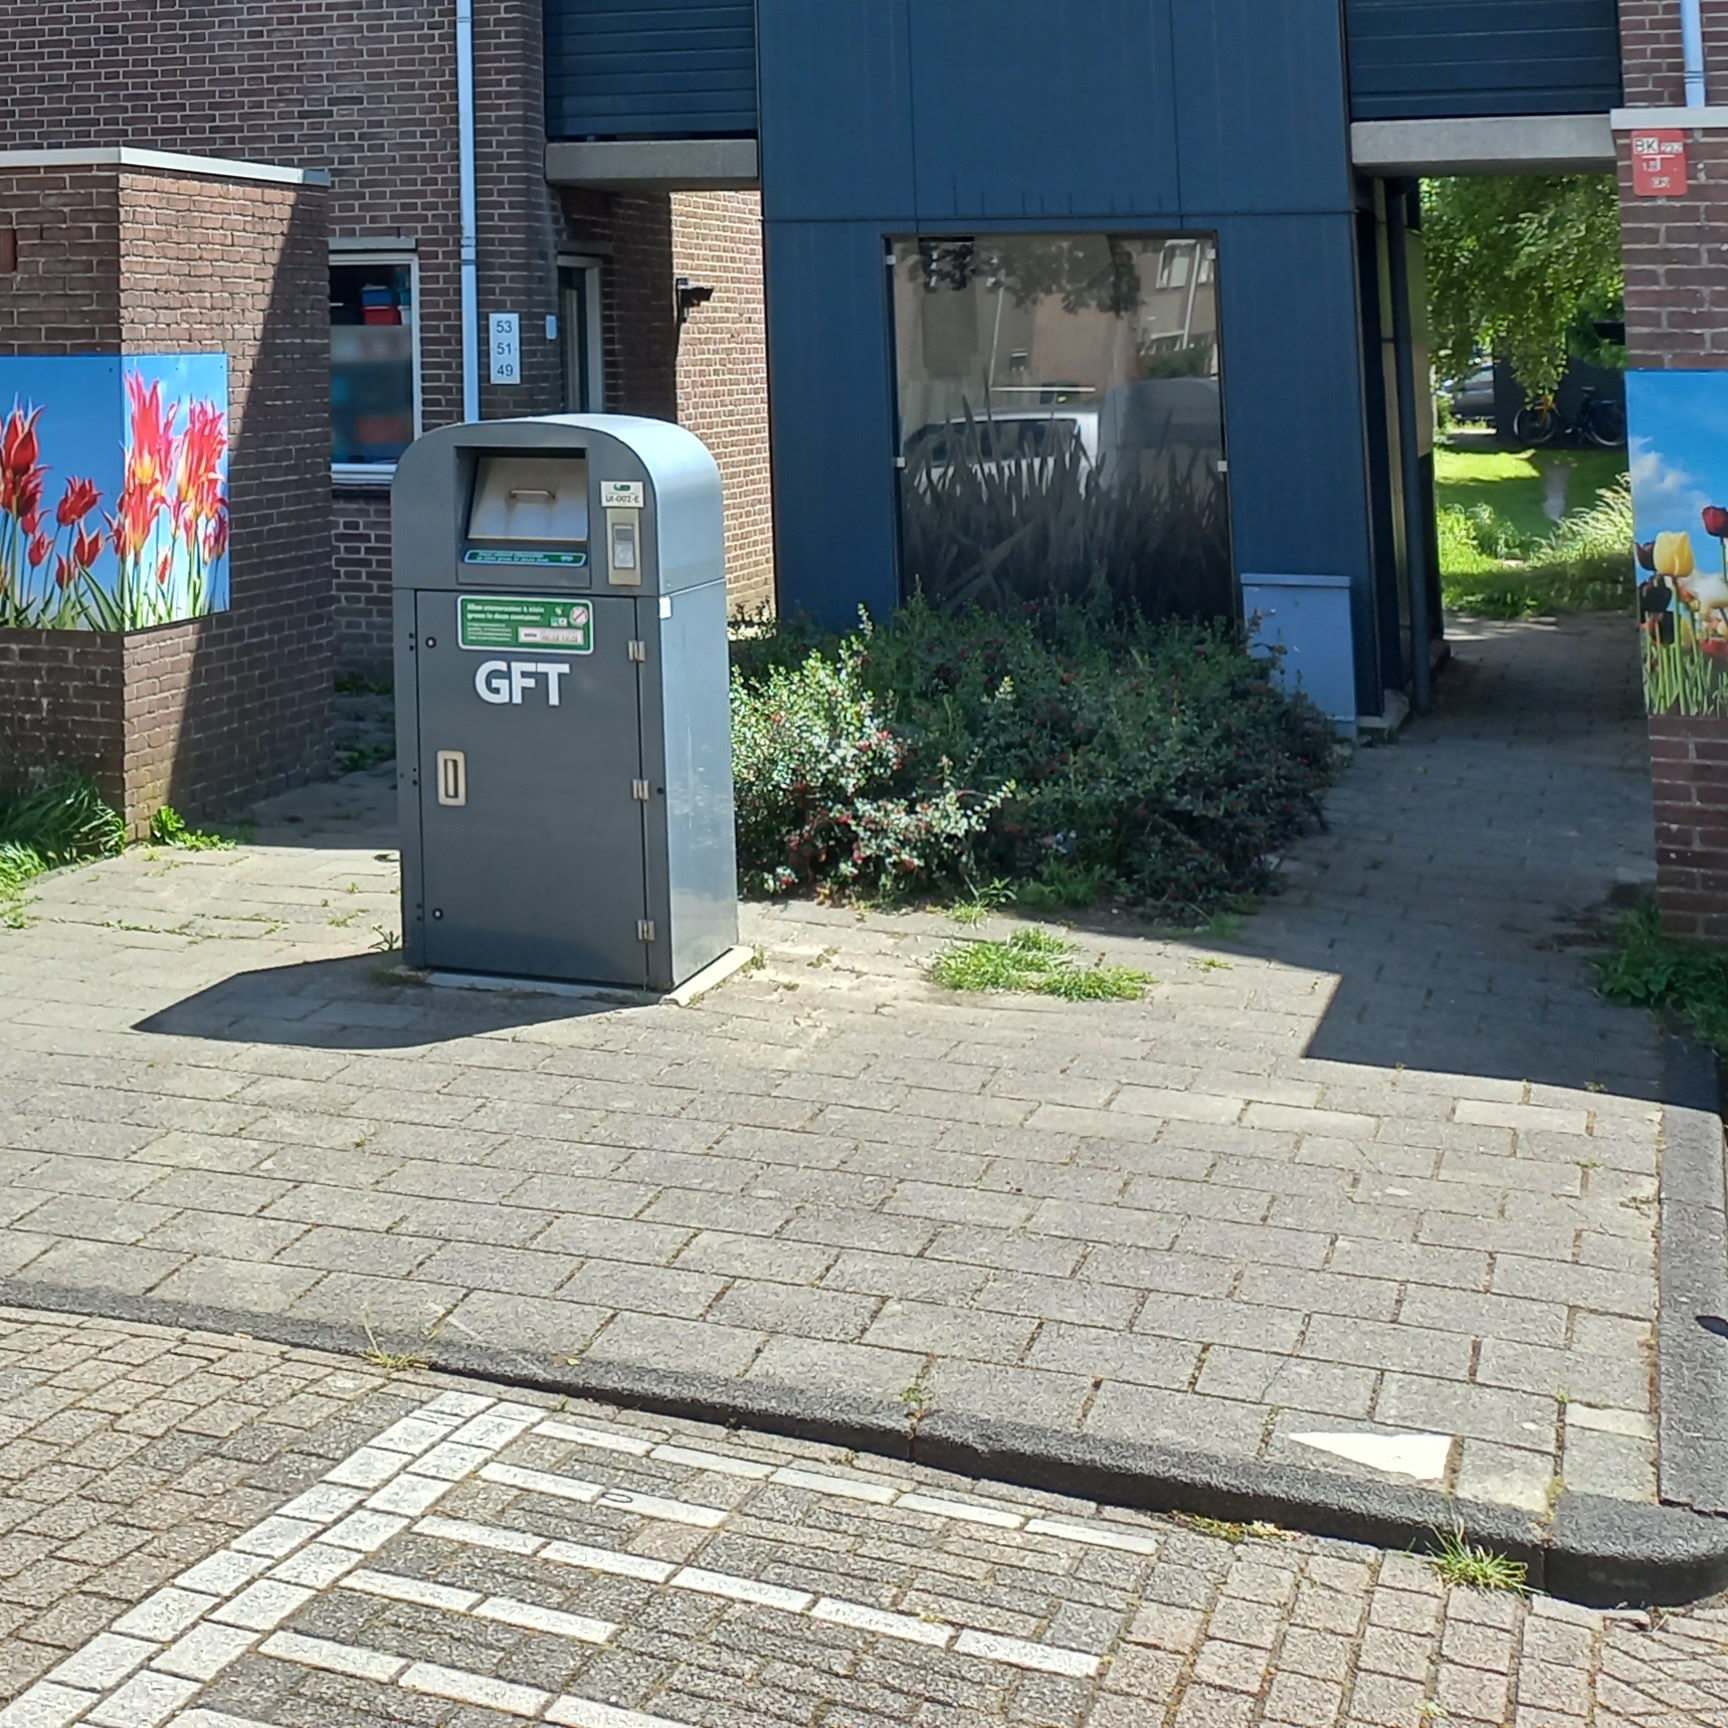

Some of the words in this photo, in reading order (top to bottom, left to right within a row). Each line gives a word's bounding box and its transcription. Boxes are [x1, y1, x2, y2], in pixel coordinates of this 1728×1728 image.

[1635, 139, 1657, 154] BK
[496, 320, 513, 334] 53
[496, 342, 512, 355] 51
[497, 363, 513, 377] 49
[475, 660, 570, 706] GFT
